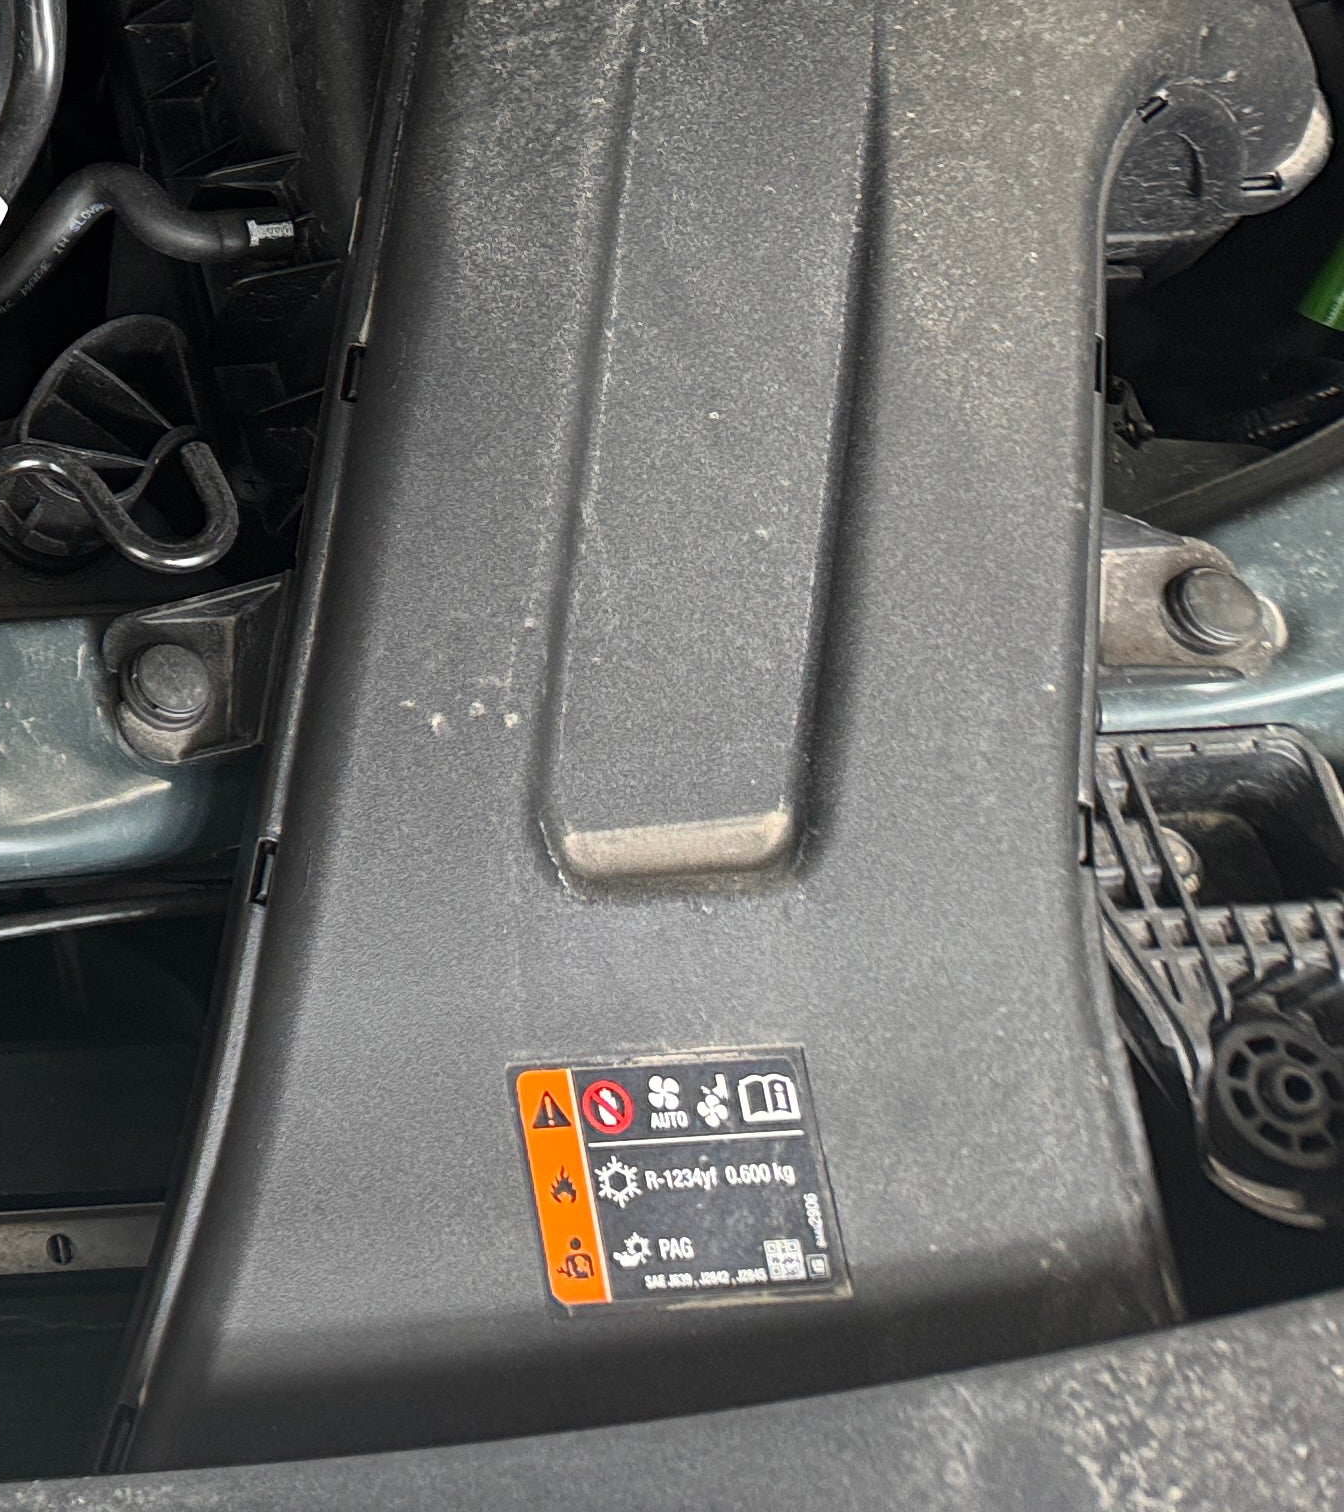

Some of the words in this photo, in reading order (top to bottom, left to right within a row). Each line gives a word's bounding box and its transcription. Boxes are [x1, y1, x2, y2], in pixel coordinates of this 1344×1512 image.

[19, 260, 51, 297] MADE
[53, 236, 71, 255] IN
[650, 1111, 689, 1129] AUTO
[645, 1165, 717, 1192] R-1234yf
[725, 1164, 771, 1185] 0.600
[772, 1162, 796, 1187] kg
[658, 1237, 696, 1260] PAG
[645, 1274, 666, 1289] SAE
